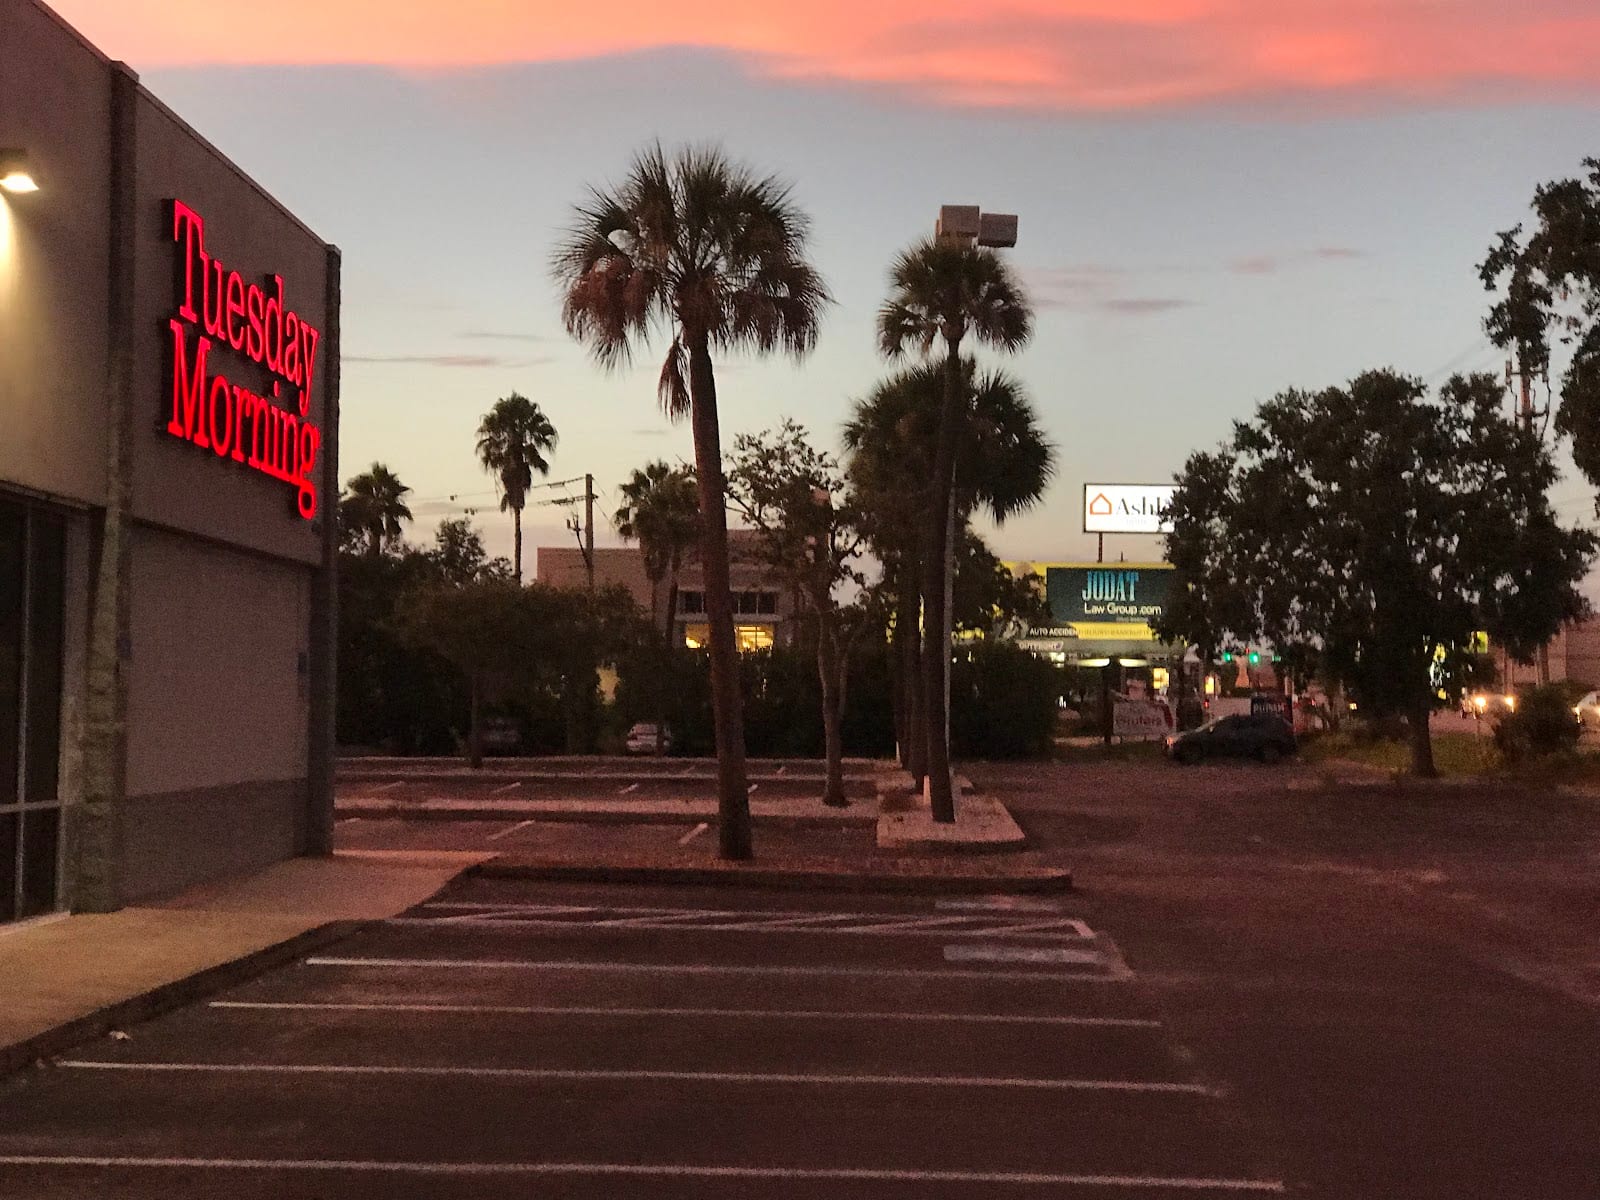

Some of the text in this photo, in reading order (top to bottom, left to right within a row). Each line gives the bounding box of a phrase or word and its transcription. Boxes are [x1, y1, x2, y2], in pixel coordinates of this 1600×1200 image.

[174, 200, 319, 416] Tuesday
[167, 319, 320, 519] Morning
[1116, 496, 1162, 515] Ashl
[1084, 602, 1105, 614] Law
[1107, 602, 1138, 616] Group
[1030, 627, 1048, 636] AUTO
